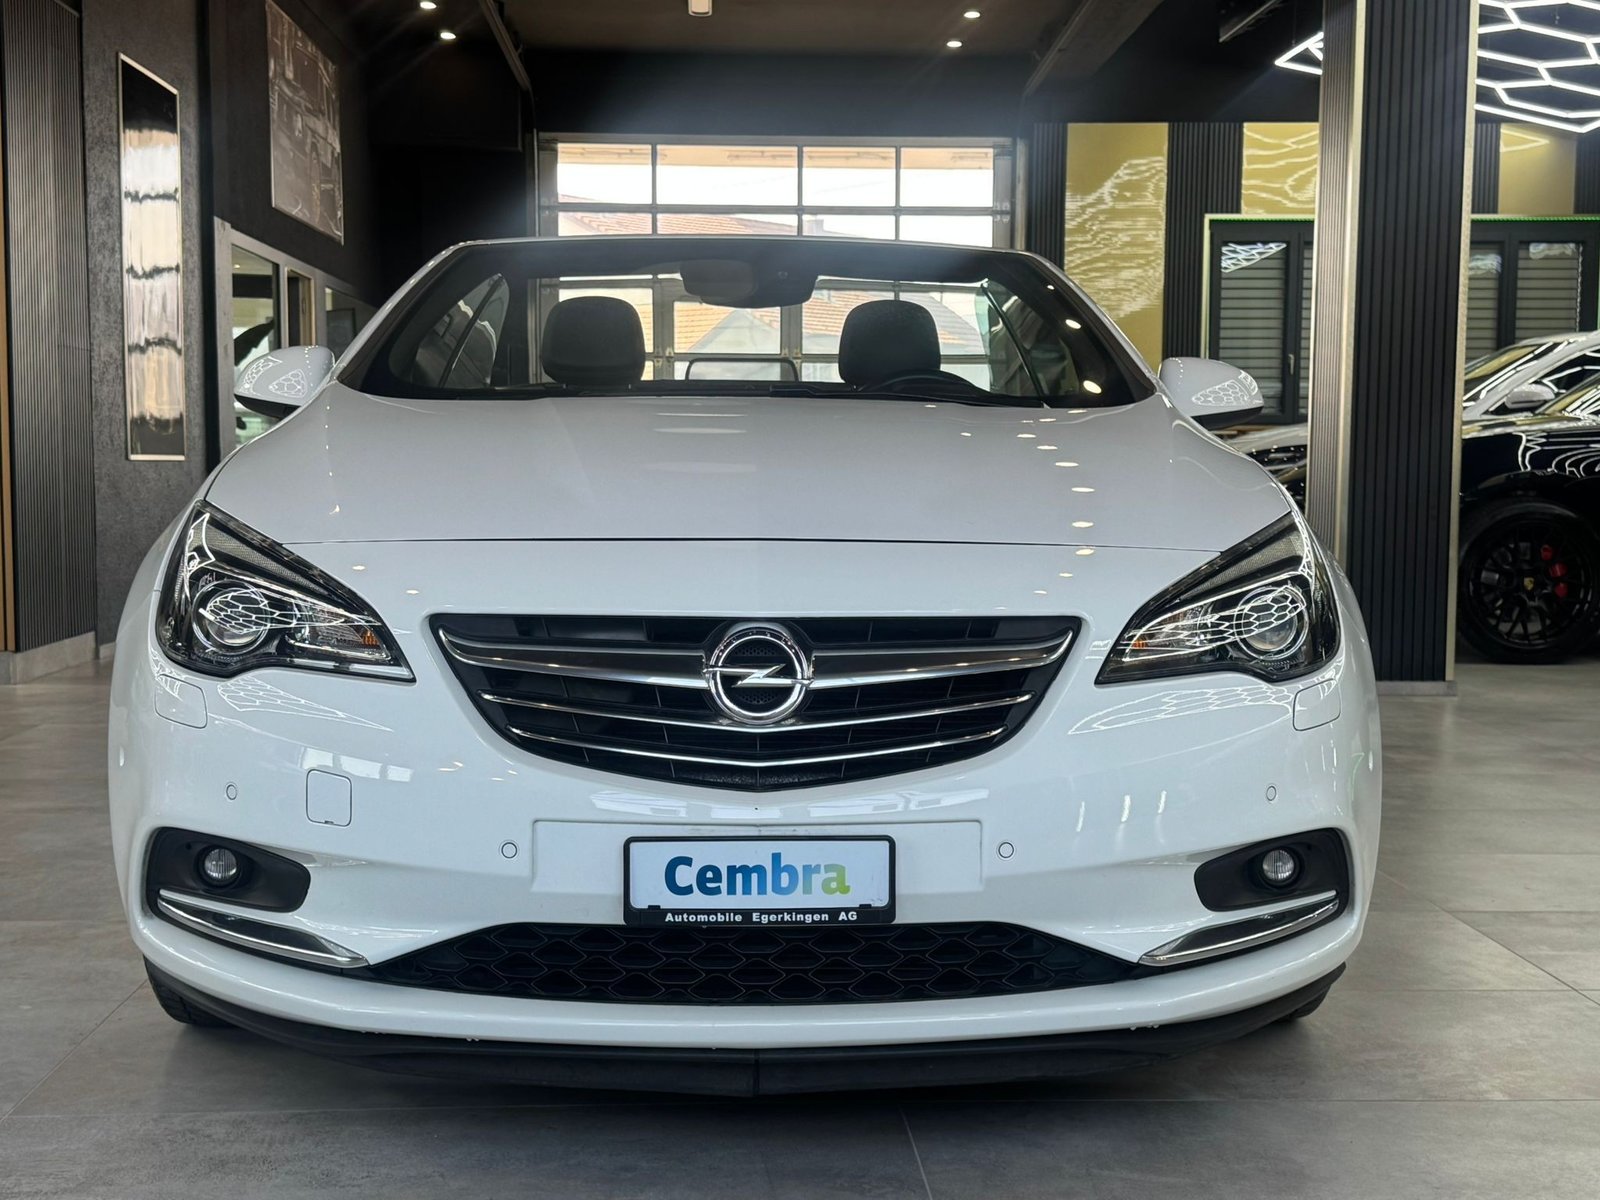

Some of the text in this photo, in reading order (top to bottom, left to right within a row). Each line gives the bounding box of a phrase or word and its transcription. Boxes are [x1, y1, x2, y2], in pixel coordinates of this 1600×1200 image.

[664, 852, 851, 896] Cembra
[665, 911, 858, 924] Automobile Egerkingen AG
